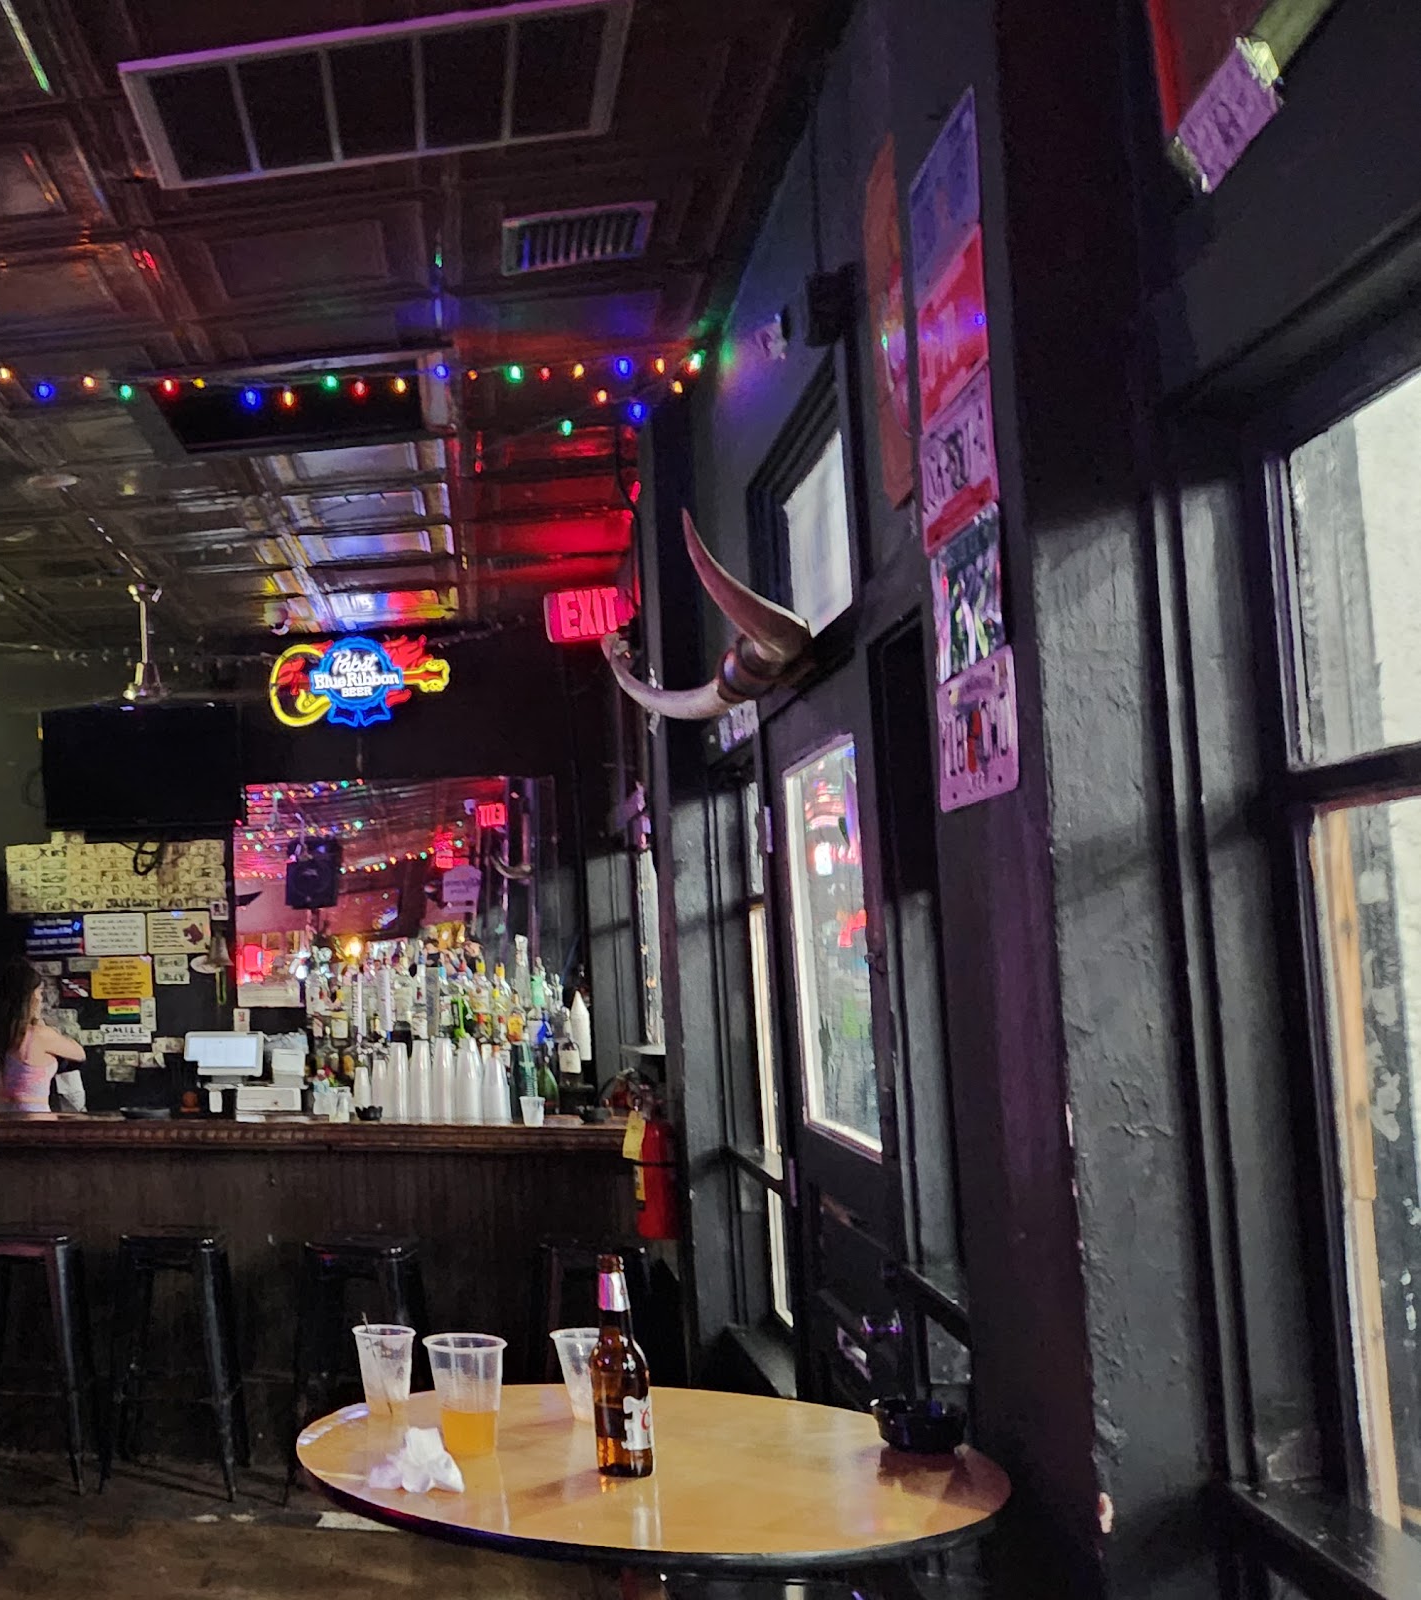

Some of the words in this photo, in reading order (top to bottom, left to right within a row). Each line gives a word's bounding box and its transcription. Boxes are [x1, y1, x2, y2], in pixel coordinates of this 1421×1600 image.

[557, 587, 619, 638] EXIT
[332, 648, 378, 675] Pabst
[314, 673, 346, 689] Blue
[347, 671, 399, 687] Ribbon
[341, 686, 372, 697] BEER
